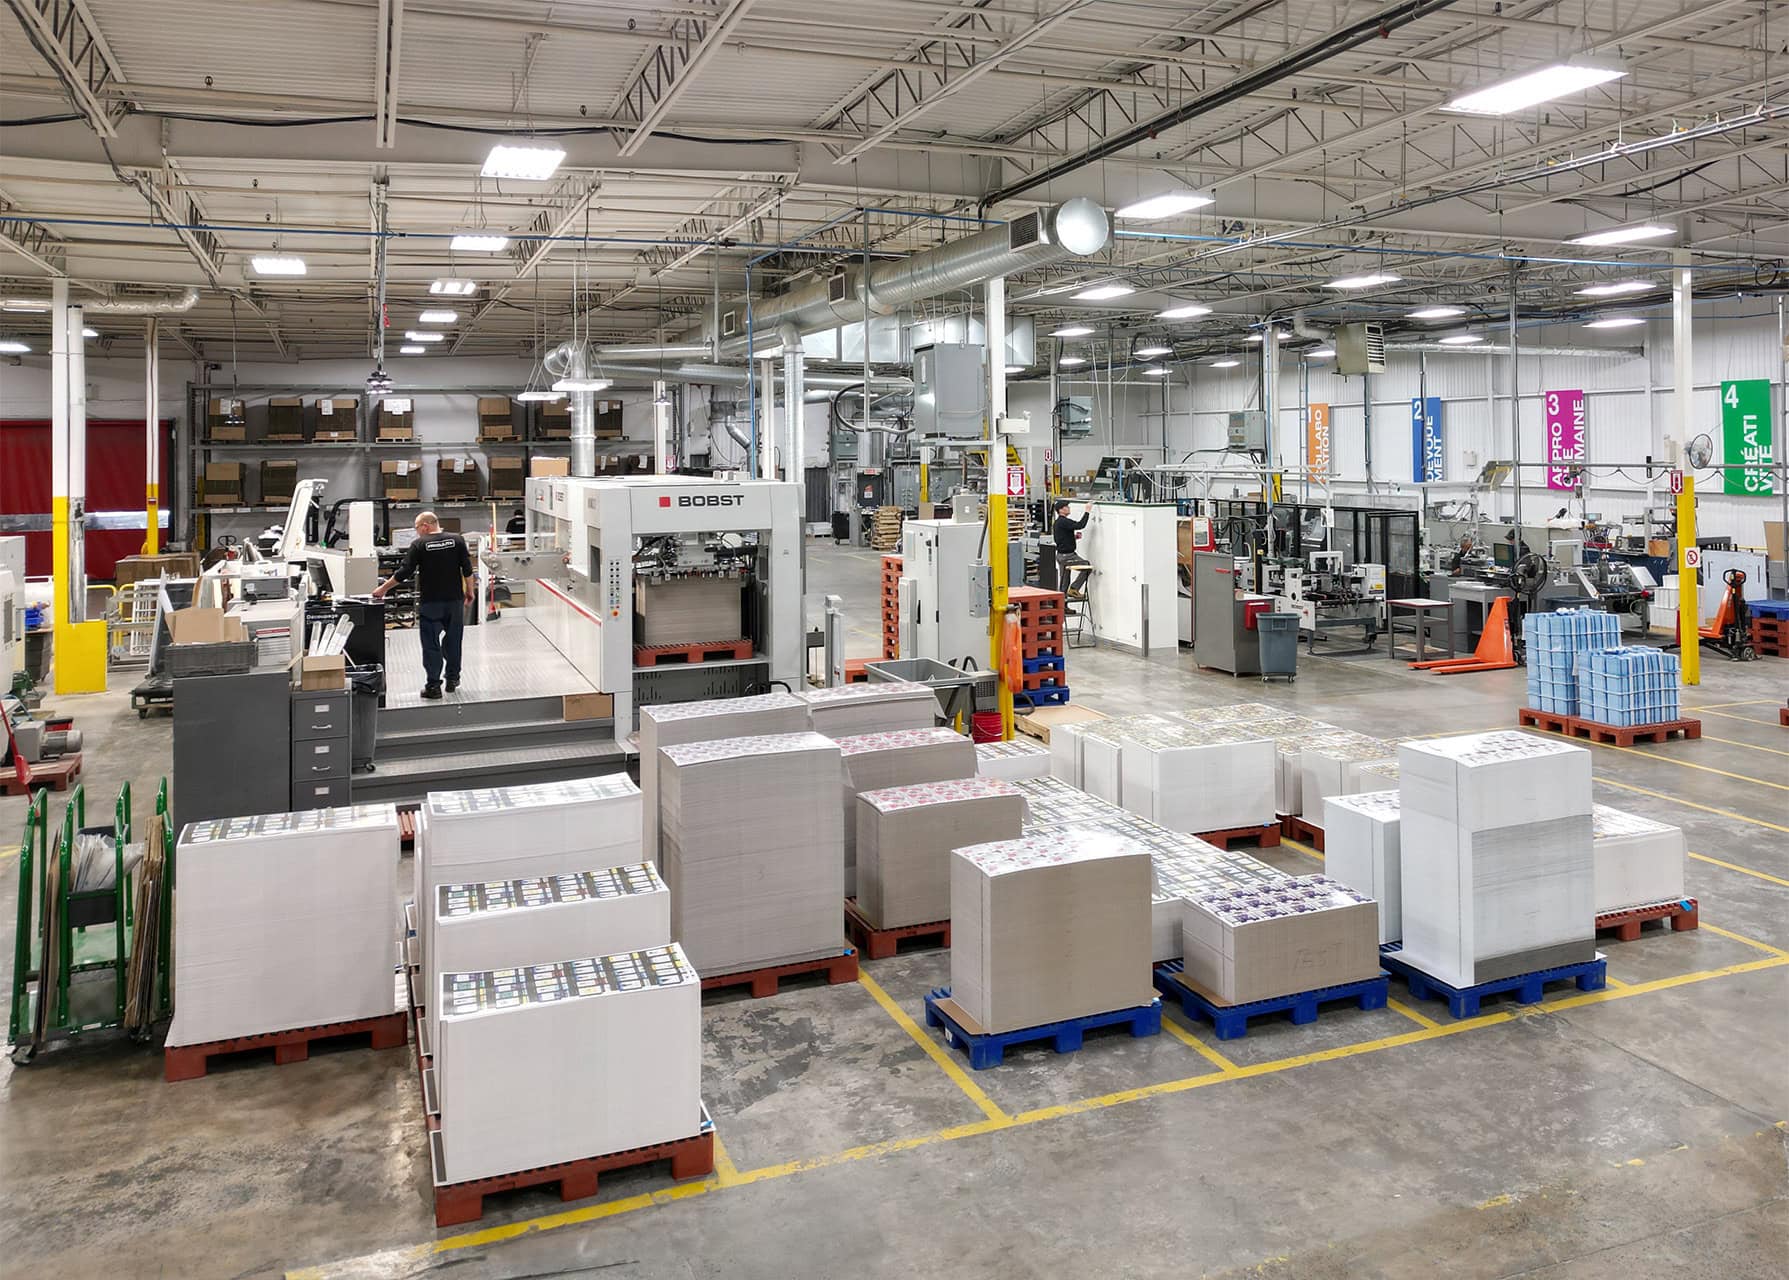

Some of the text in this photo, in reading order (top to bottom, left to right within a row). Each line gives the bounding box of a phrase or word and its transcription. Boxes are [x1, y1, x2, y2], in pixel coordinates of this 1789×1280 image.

[1548, 393, 1560, 416] 3
[1724, 384, 1739, 409] 4
[1414, 400, 1423, 420] 2
[1573, 399, 1585, 486] HMAINE
[1740, 414, 1759, 492] CRÉATI
[1433, 435, 1443, 482] MENT
[678, 495, 745, 507] BOBST
